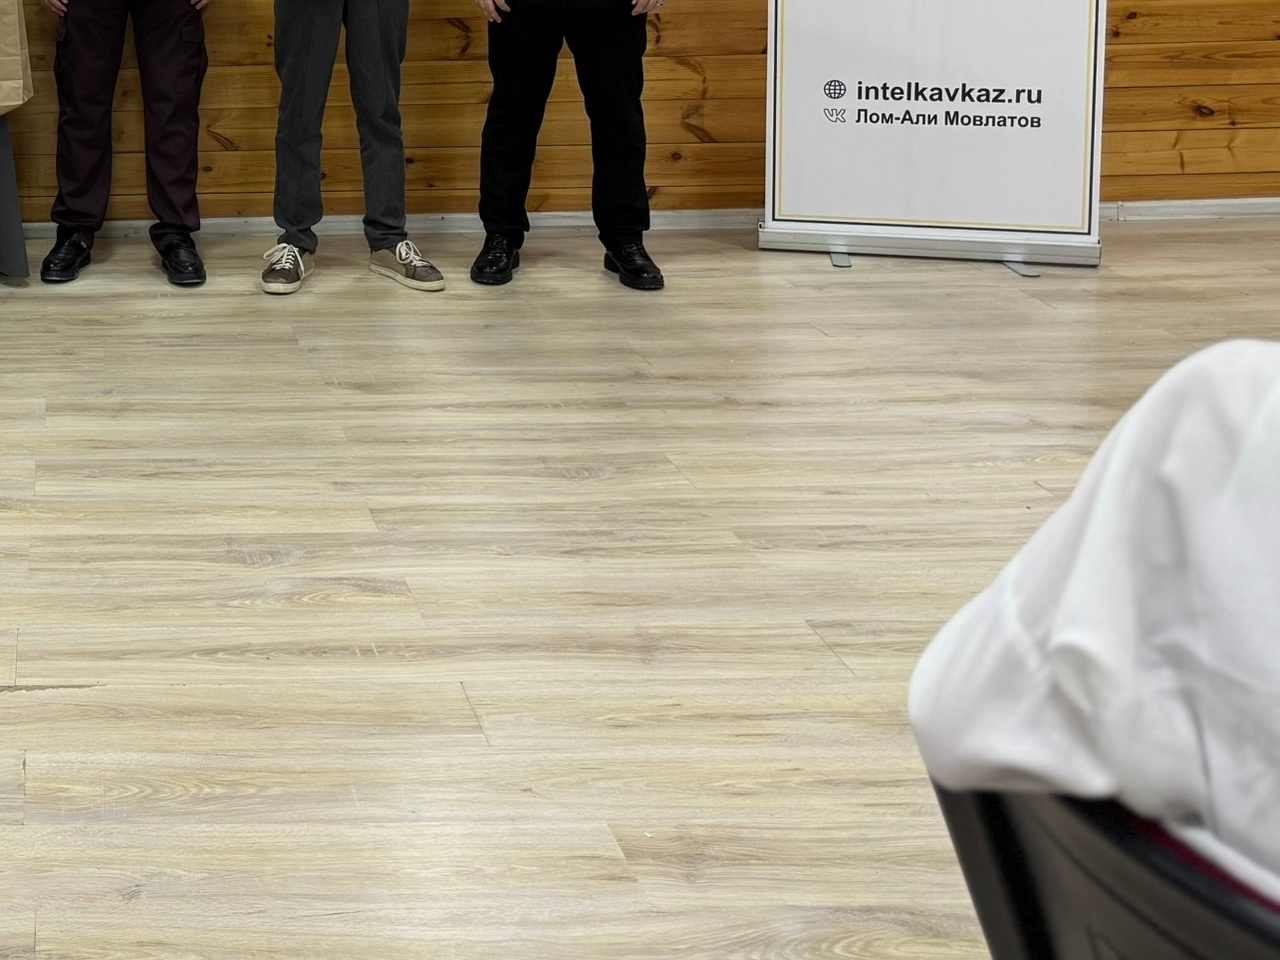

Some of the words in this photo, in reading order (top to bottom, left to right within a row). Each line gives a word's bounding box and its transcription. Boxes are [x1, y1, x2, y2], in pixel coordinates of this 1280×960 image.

[857, 81, 1042, 104] intelkavkaz.ru
[855, 108, 938, 125] Лом-Али
[944, 110, 1042, 128] Мовлатов
